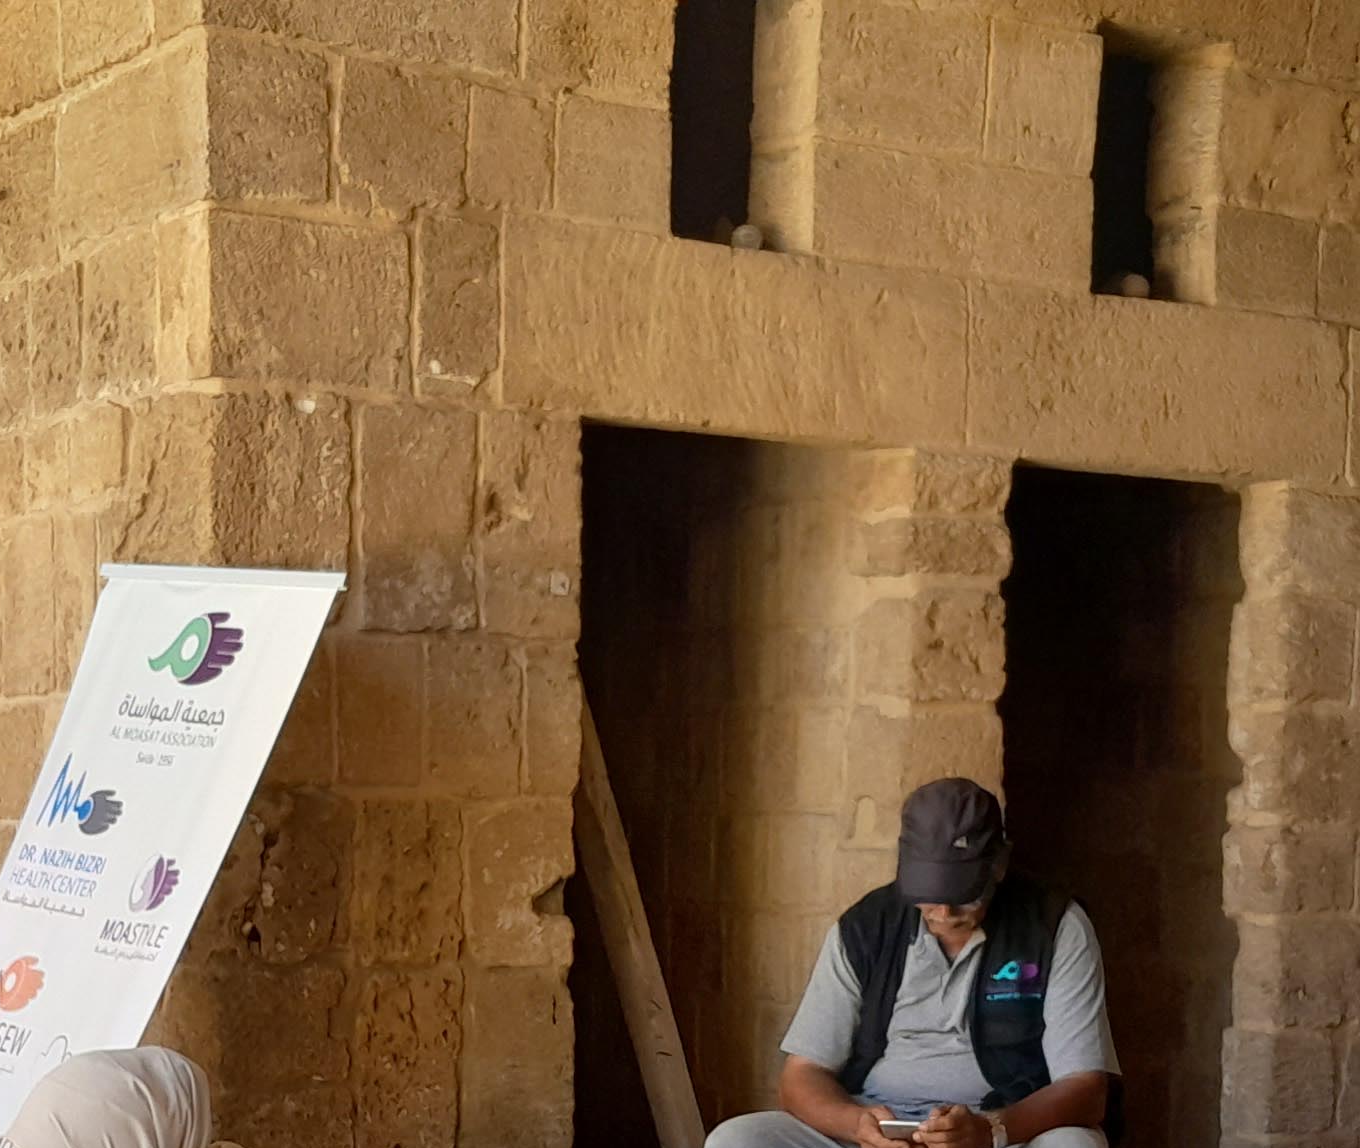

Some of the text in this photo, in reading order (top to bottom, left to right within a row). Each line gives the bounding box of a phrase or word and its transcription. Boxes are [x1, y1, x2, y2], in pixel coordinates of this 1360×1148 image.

[118, 694, 225, 732] جمعية المواساة
[19, 843, 107, 874] DR. NAZIH BIZRI
[11, 867, 97, 898] HEALTH CENTER
